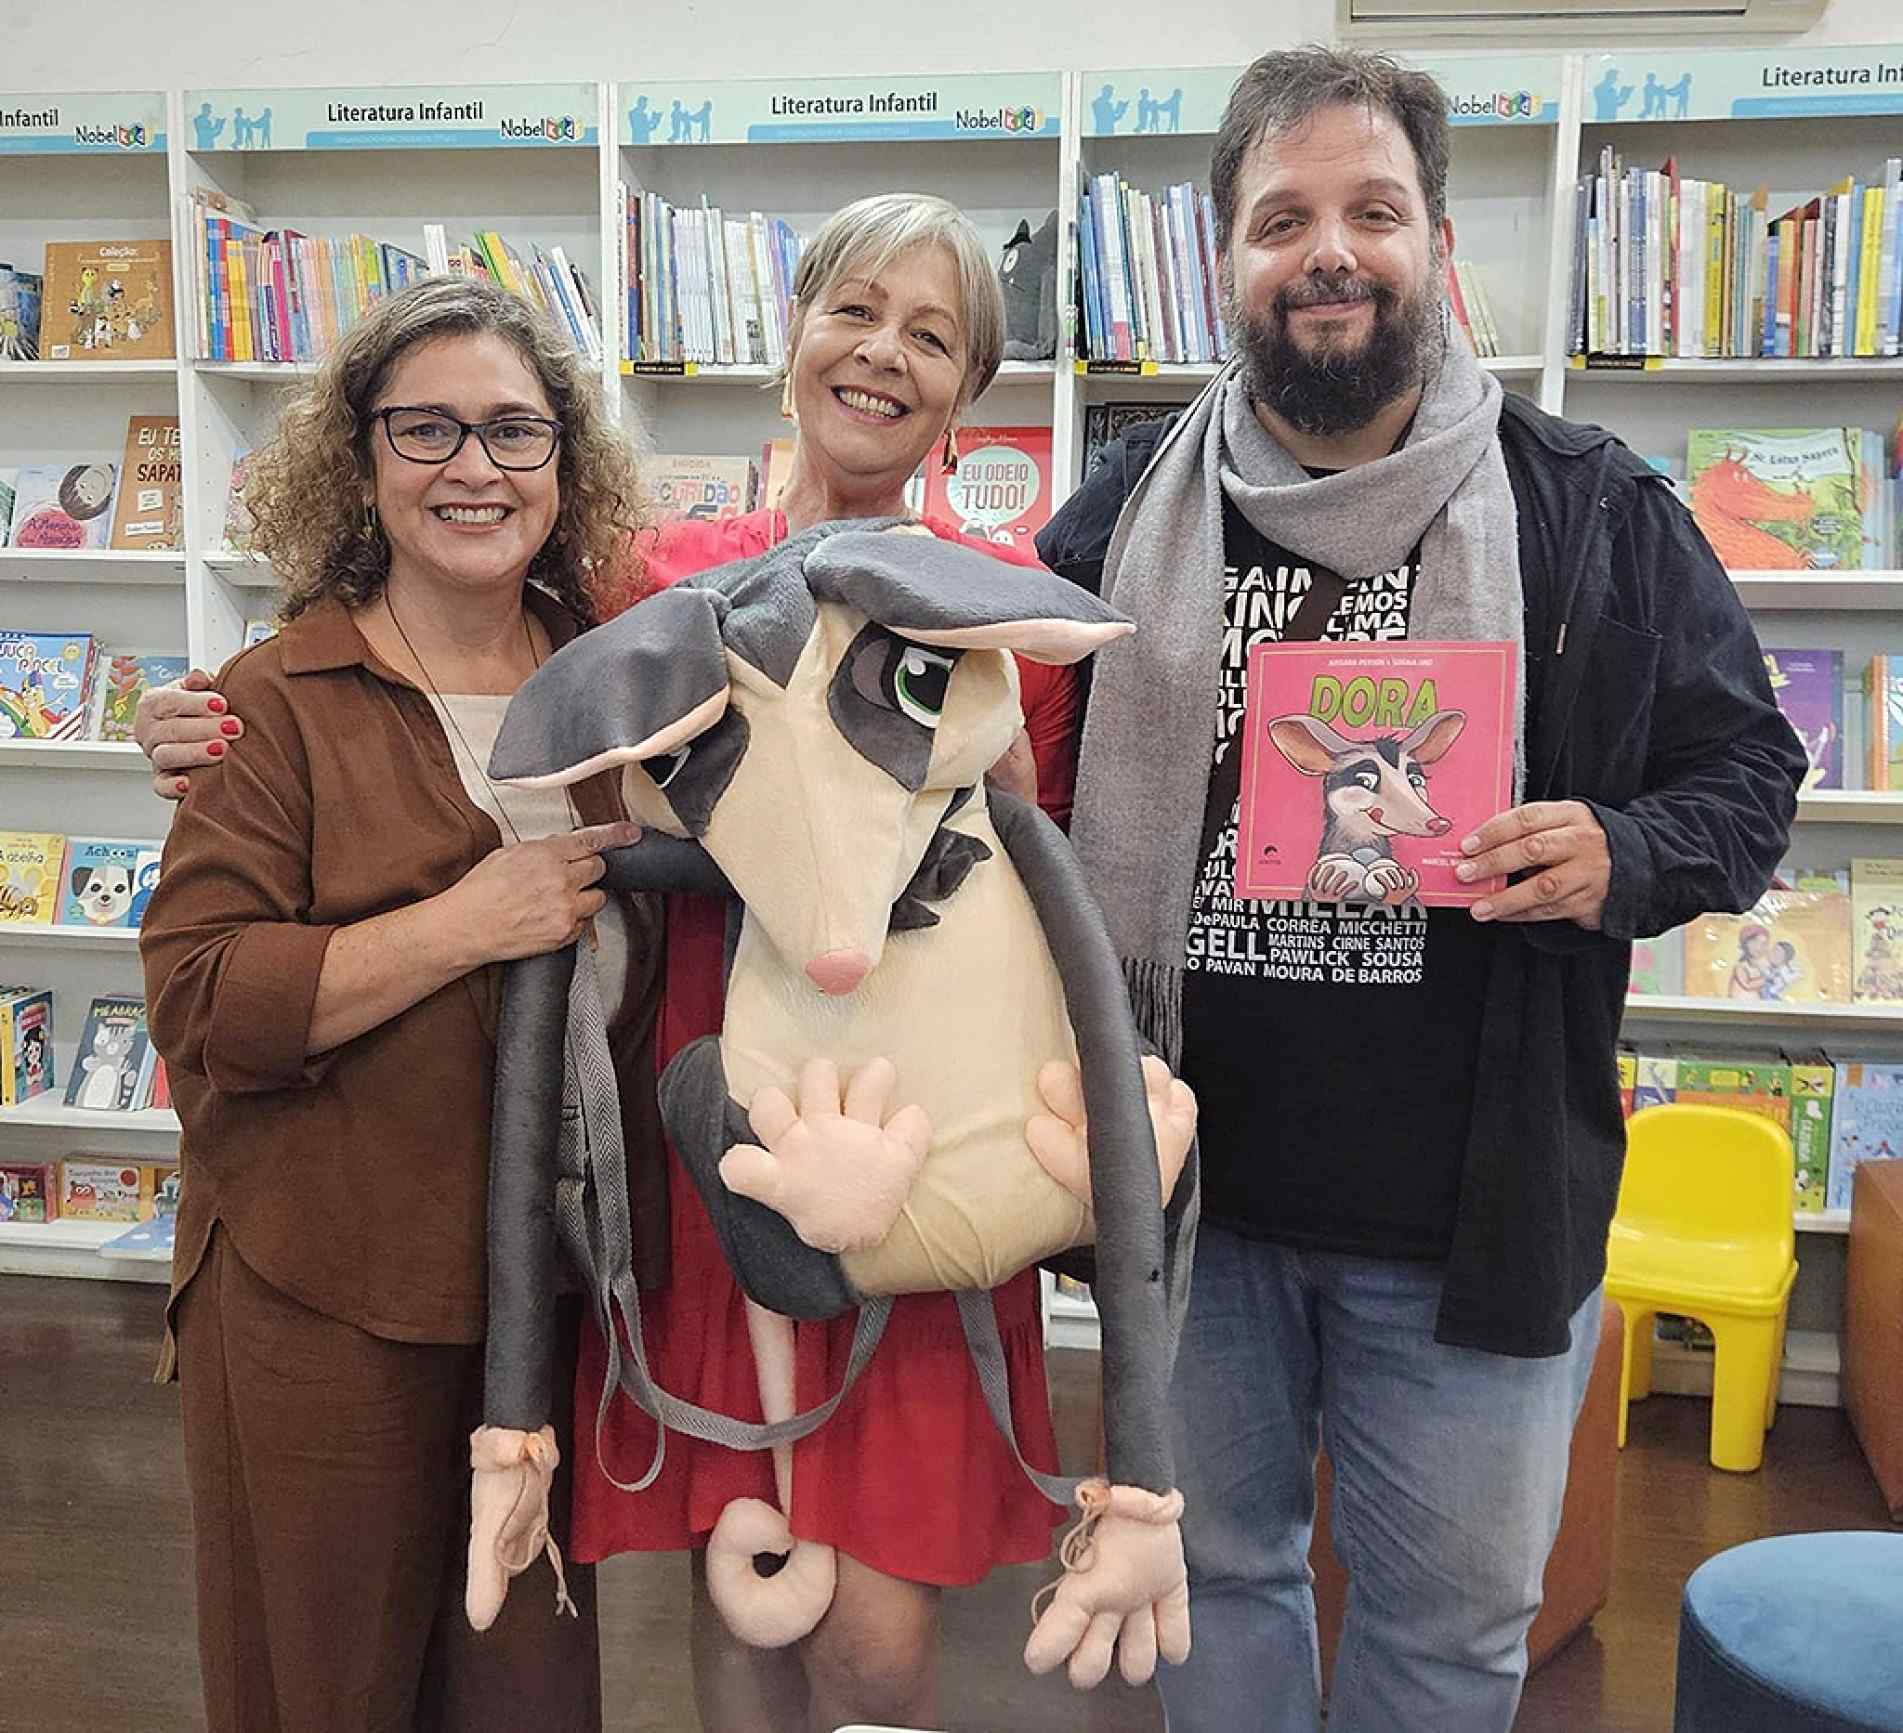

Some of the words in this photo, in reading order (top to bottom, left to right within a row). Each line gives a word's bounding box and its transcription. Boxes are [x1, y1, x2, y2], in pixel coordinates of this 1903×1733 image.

[1762, 66, 1870, 87] Literatura
[328, 103, 414, 122] Literatura
[420, 101, 483, 120] Infantil
[771, 96, 863, 115] Literatura
[869, 92, 938, 113] Infantil
[0, 108, 59, 127] Infantil
[956, 109, 1003, 130] Nobel
[75, 125, 118, 144] Nobel
[501, 118, 546, 137] Nobel
[138, 428, 156, 445] EU
[962, 463, 981, 481] EU
[987, 463, 1029, 481] ODEIO
[961, 484, 1026, 510] TUDO!
[1310, 673, 1439, 728] DORA
[1337, 920, 1428, 935] MICCHETTI
[1268, 933, 1325, 950] MARTINS
[1332, 936, 1371, 950] CIRNE
[1375, 937, 1426, 951] SANTOS
[1270, 948, 1350, 967] PAWLICK
[1361, 950, 1424, 967] SOUSA
[1205, 957, 1257, 976] PAVAN
[1263, 963, 1325, 982] MOURA
[1332, 967, 1356, 983] DE
[1358, 968, 1424, 984] BARROS
